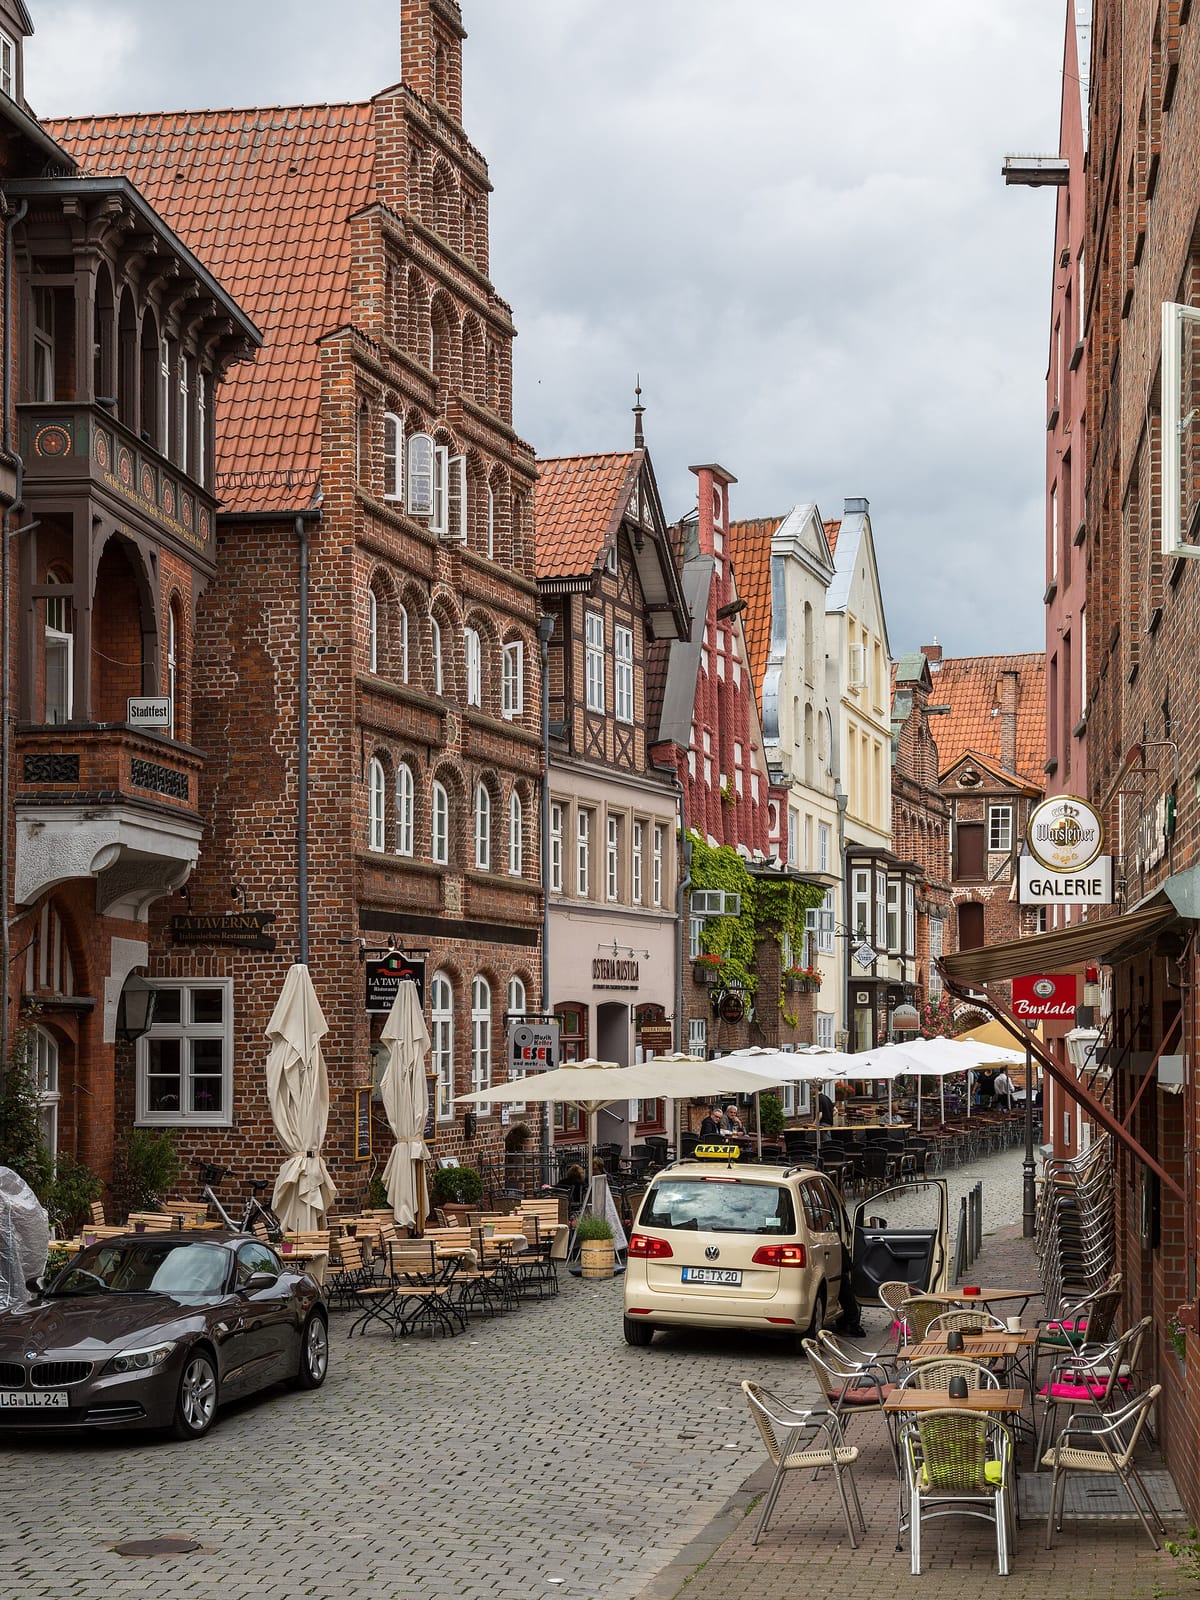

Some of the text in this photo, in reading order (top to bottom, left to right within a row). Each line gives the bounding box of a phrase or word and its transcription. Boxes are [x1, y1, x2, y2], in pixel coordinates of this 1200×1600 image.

[131, 705, 167, 718] Stadtfest
[1036, 822, 1095, 844] Warsteiner
[1029, 879, 1102, 896] GALERIE
[175, 916, 261, 929] LA TAVERNA
[221, 931, 258, 940] Restaurant
[592, 958, 639, 981] OSTERIA RUSTICA
[368, 977, 379, 986] LA
[1014, 999, 1075, 1015] Burlala
[698, 1144, 733, 1154] TAXI
[691, 1269, 738, 1282] LG TX 20
[1, 1393, 18, 1406] LG
[25, 1393, 41, 1406] LL
[44, 1393, 59, 1406] 24
